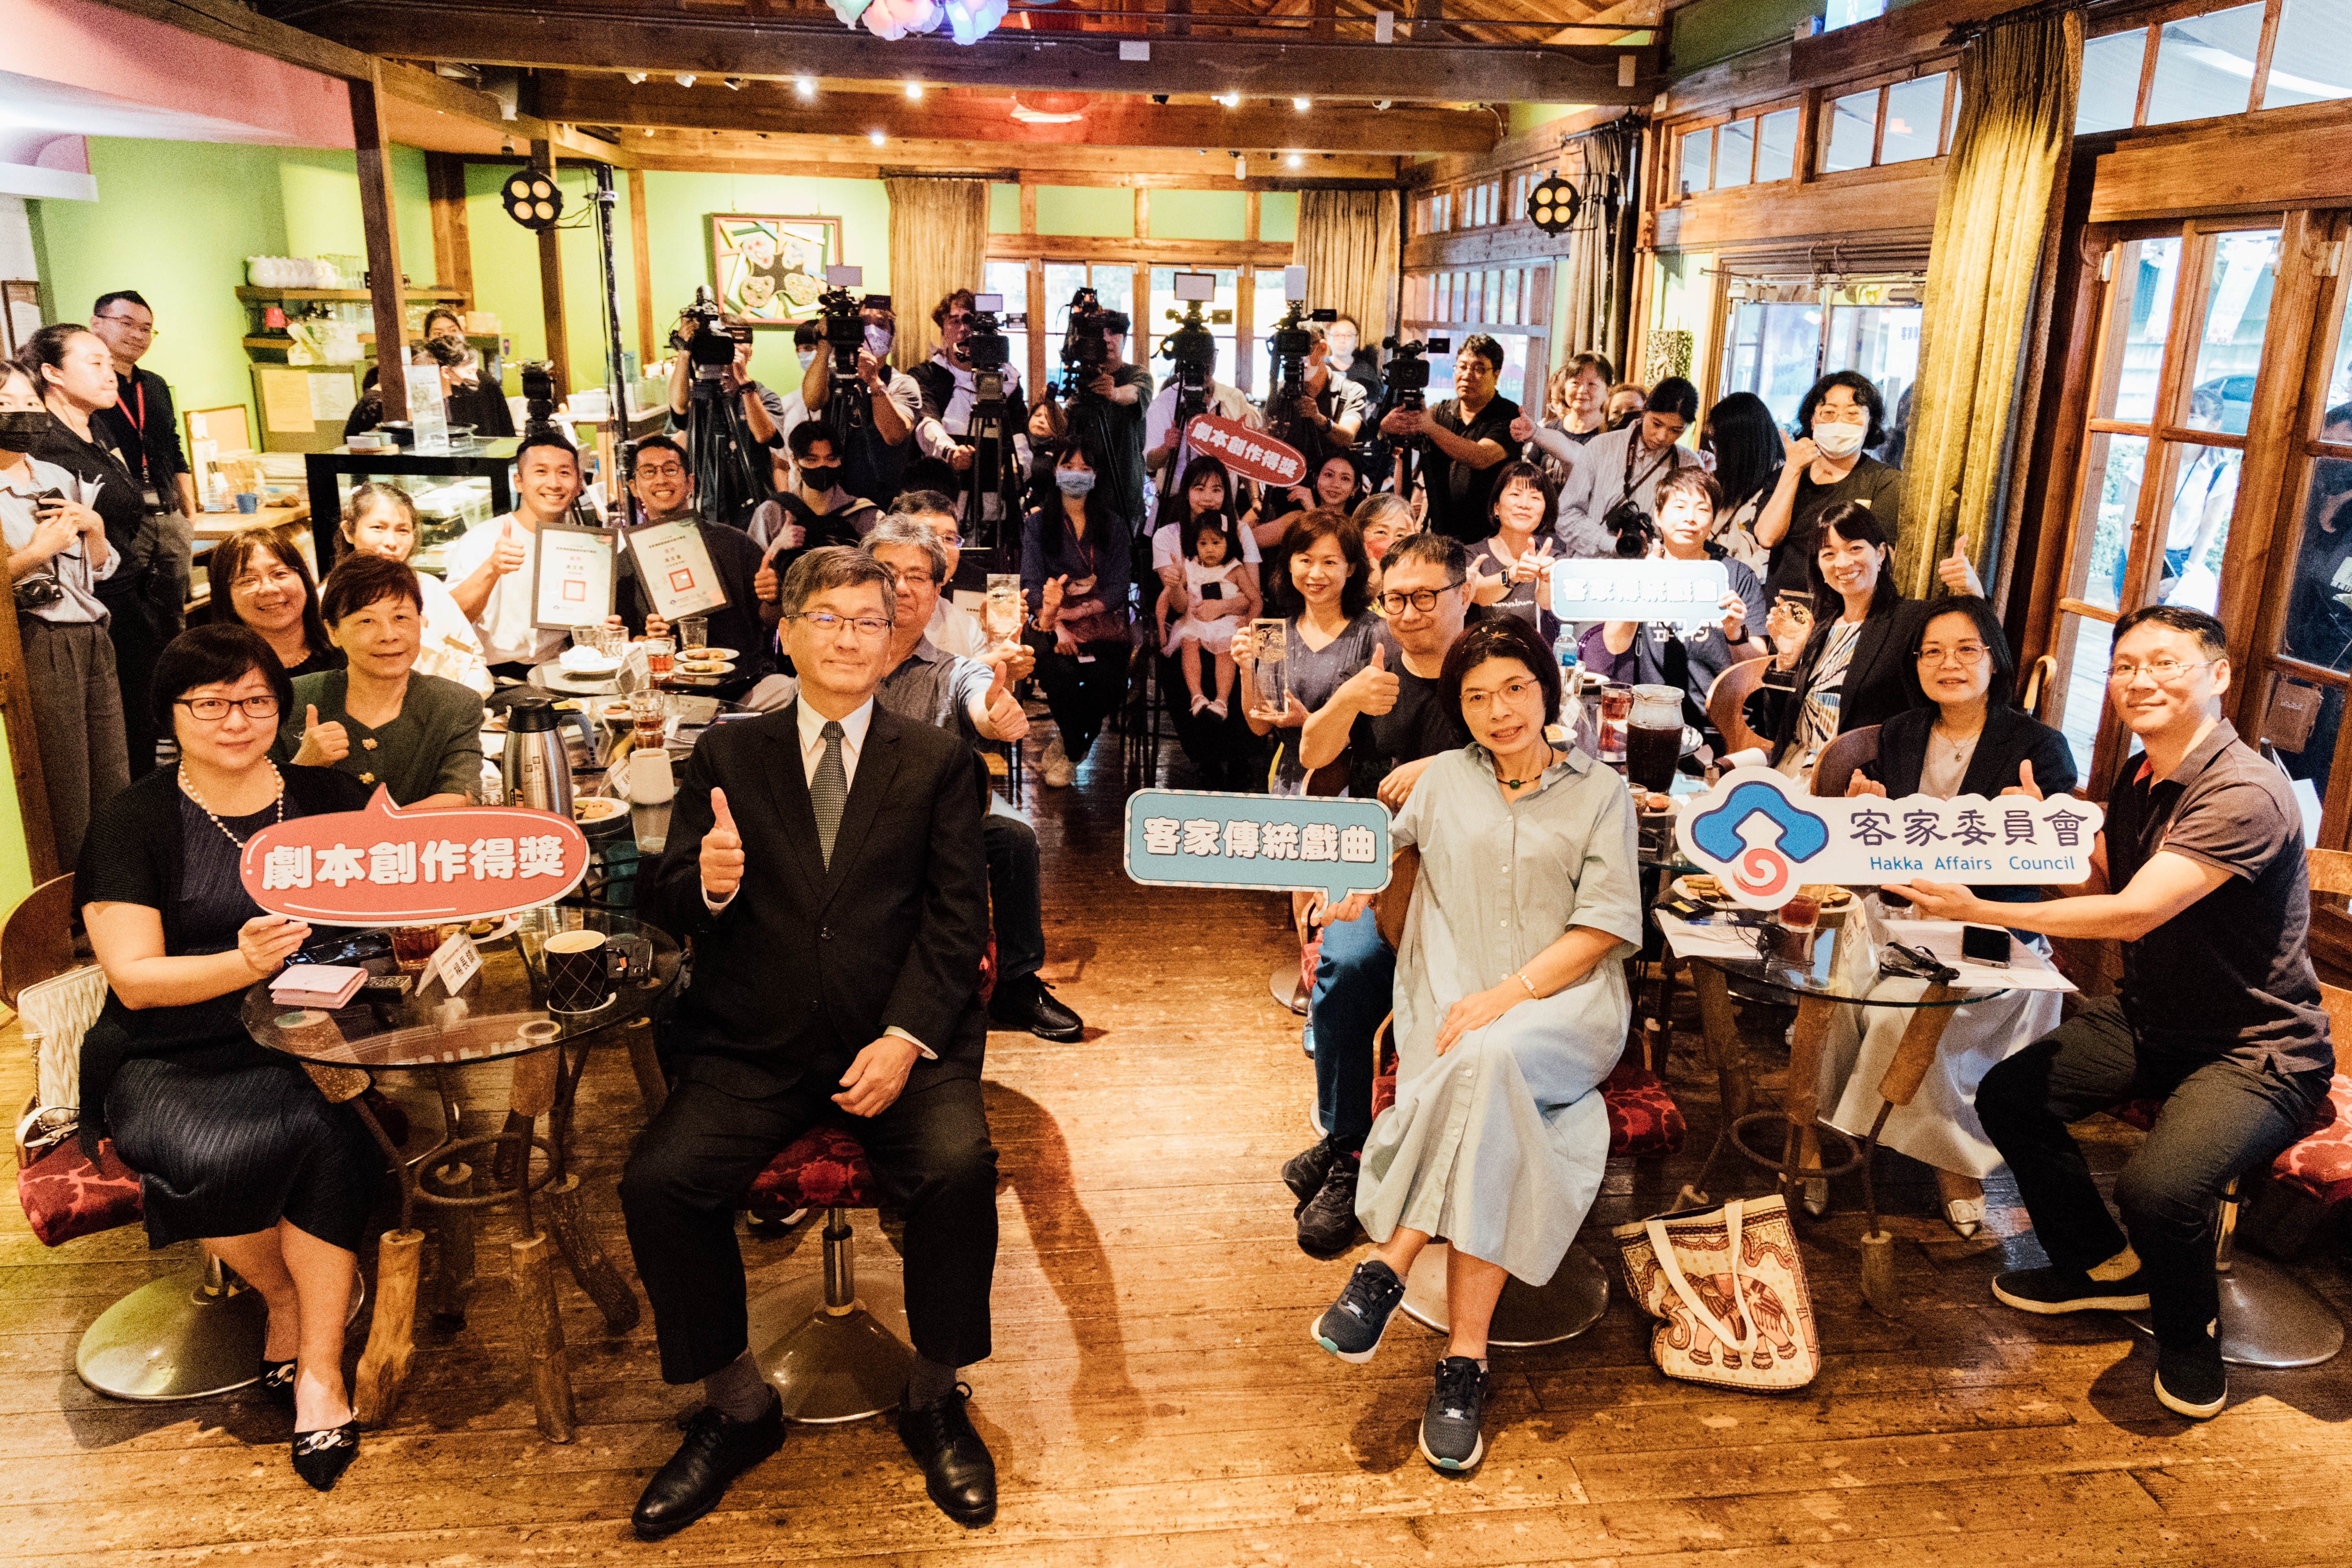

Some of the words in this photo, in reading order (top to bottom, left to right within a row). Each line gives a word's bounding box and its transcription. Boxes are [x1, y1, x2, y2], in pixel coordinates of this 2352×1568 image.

[1191, 421, 1298, 478] 劇本創作得獎
[1143, 816, 1376, 863] 客家傳統戲曲
[1850, 809, 2088, 846] 客家委員會
[262, 834, 565, 890] 劇本創作得獎
[1870, 856, 1923, 870] Hakka
[1935, 856, 1992, 870] Affairs
[2009, 856, 2074, 870] Council
